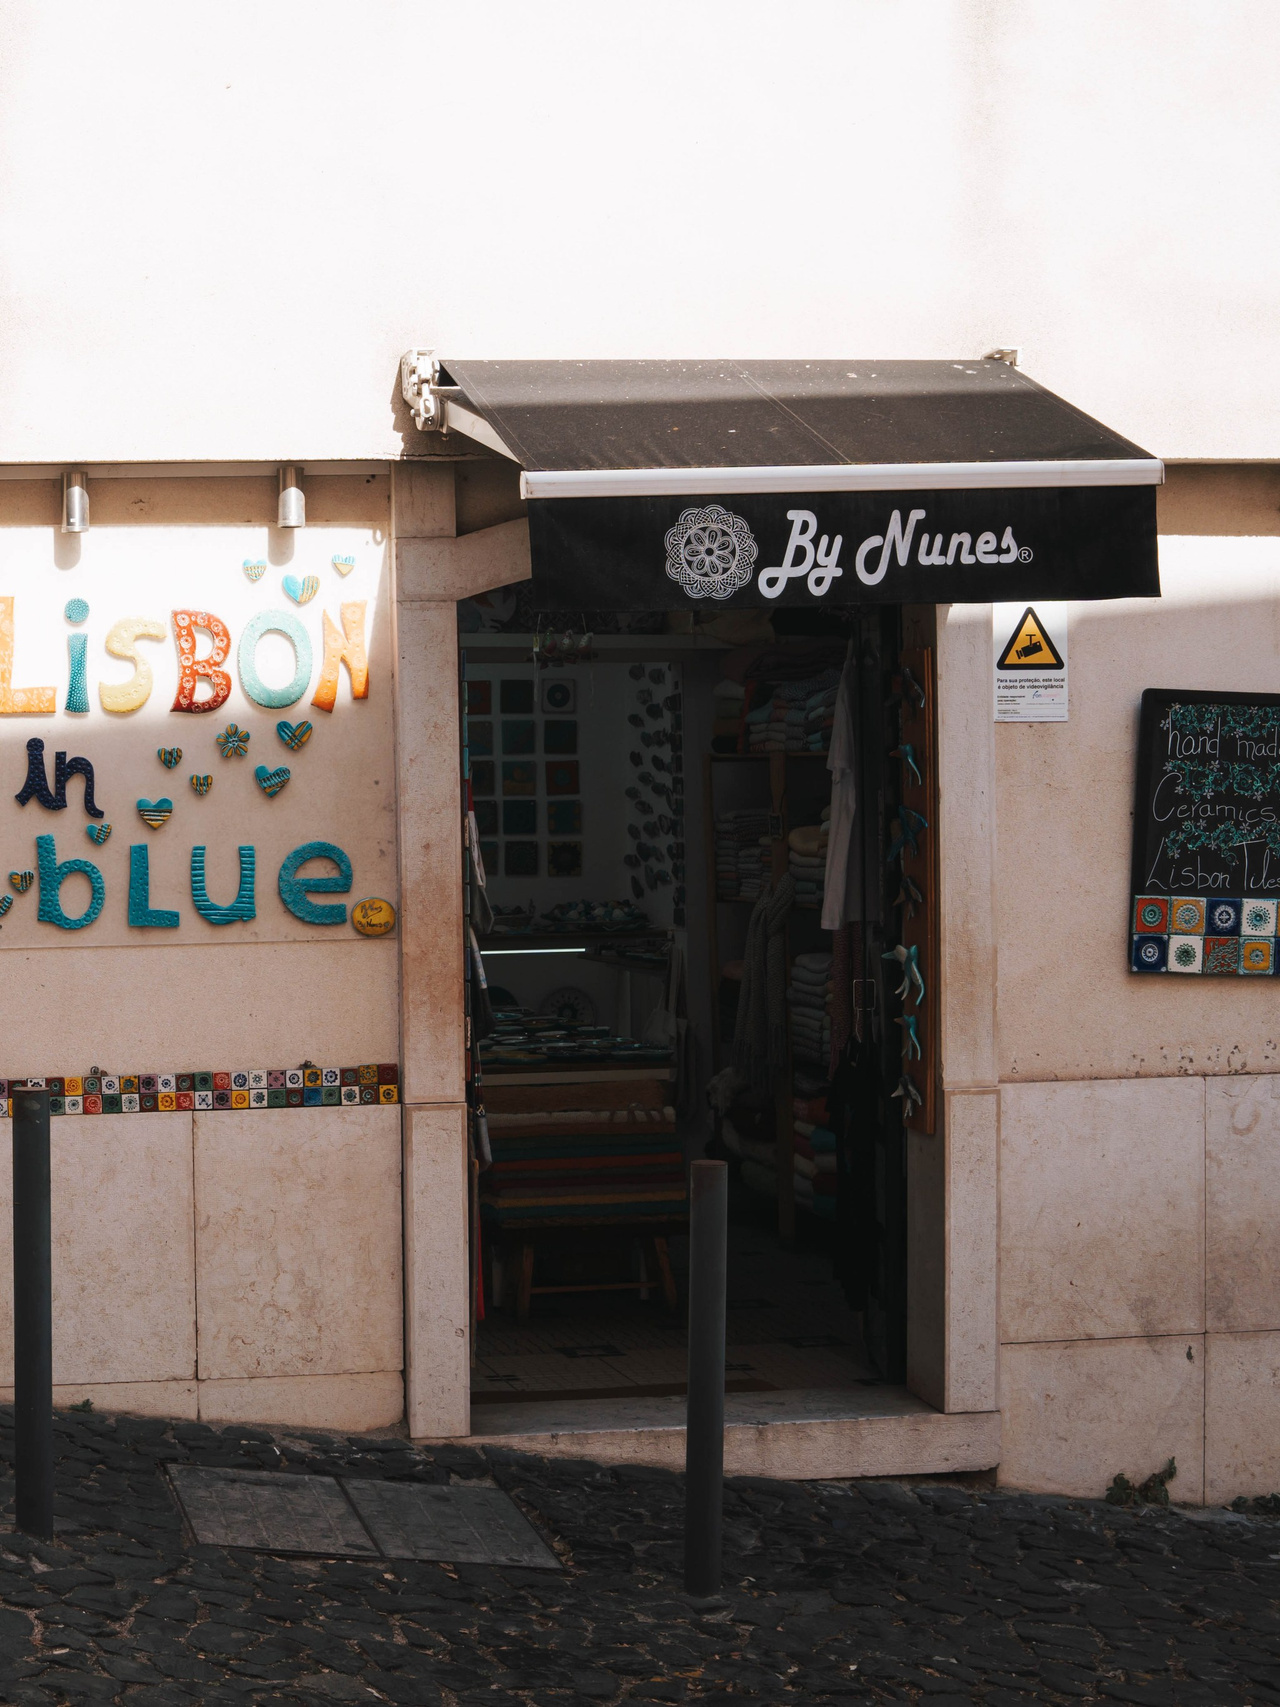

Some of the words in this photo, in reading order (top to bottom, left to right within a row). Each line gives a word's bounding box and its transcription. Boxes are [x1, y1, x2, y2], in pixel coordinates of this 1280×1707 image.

[757, 509, 843, 599] By
[1167, 711, 1222, 759] hand
[1237, 726, 1280, 761] mad
[14, 737, 105, 819] in
[1152, 772, 1276, 823] Ceramics
[1145, 836, 1230, 890] Lisbon
